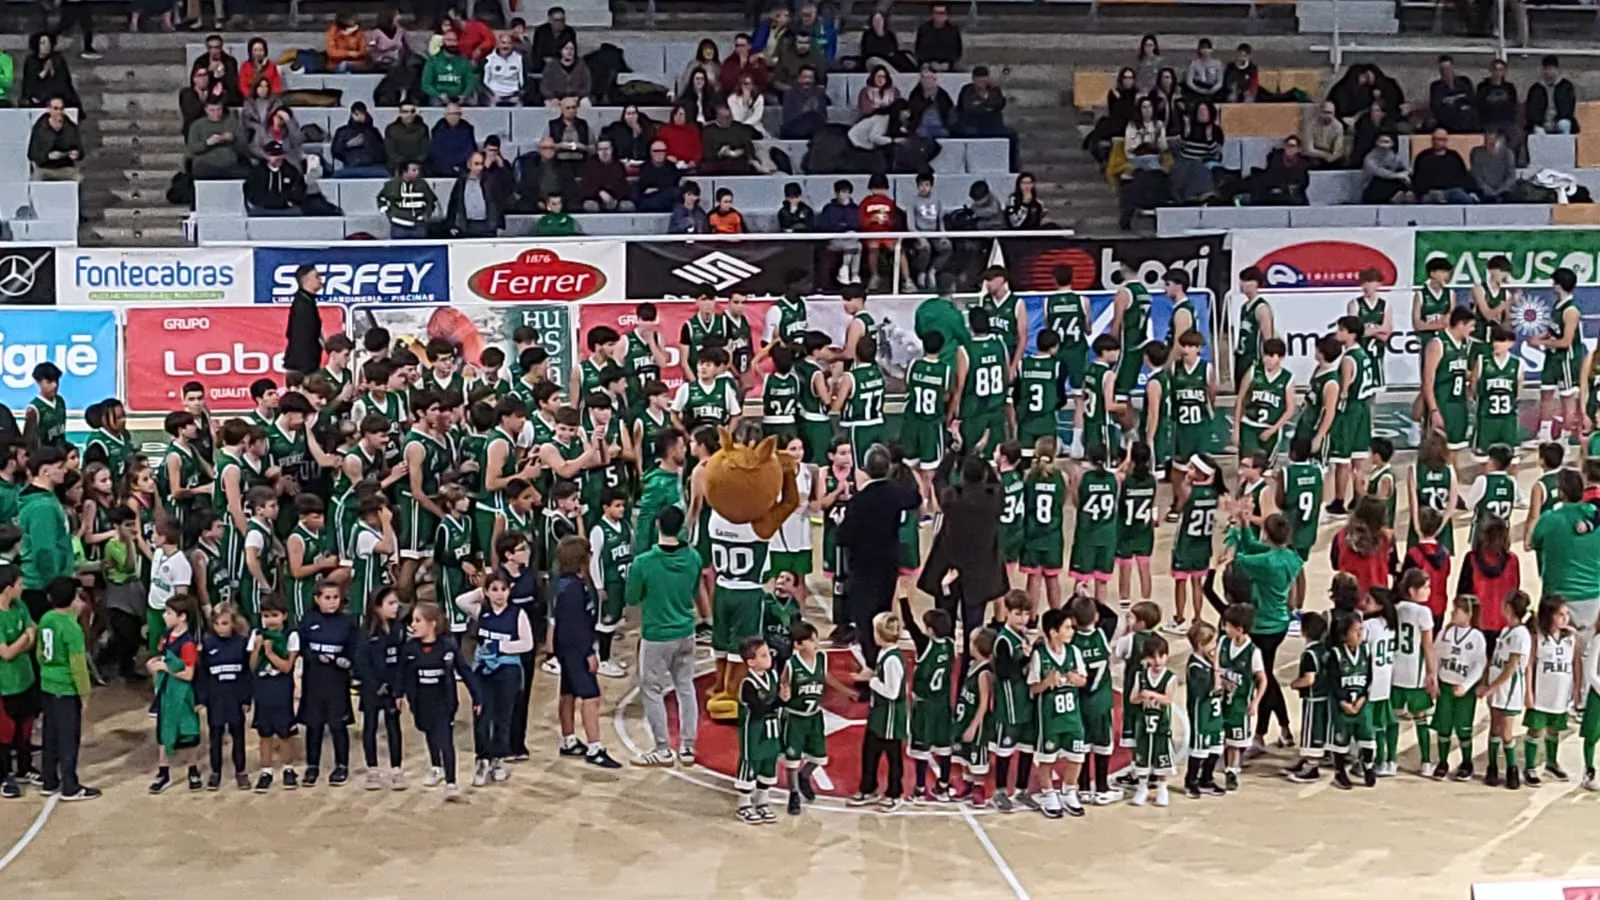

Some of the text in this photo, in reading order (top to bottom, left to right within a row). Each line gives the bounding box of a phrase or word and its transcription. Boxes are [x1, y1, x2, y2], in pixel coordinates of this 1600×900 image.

[525, 254, 551, 263] 1876
[489, 269, 591, 295] Ferrer
[391, 294, 435, 302] PISCINAS
[163, 318, 210, 330] GRUPO
[1052, 317, 1081, 342] 44
[976, 366, 1003, 396] 88
[1453, 376, 1463, 396] 8
[860, 389, 884, 420] 77
[914, 387, 937, 415] 18
[1029, 384, 1044, 411] 3
[1489, 395, 1512, 414] 33
[1179, 406, 1203, 424] 20
[1258, 409, 1269, 423] 2
[605, 466, 619, 488] 5
[1000, 494, 1025, 523] 34
[1037, 494, 1053, 523] 8
[1083, 494, 1114, 521] 49
[1125, 499, 1152, 525] 14
[1300, 492, 1314, 521] 9
[711, 543, 754, 576] 00
[1089, 661, 1108, 691] 7
[804, 700, 816, 713] 7
[955, 703, 965, 722] 9
[1055, 692, 1076, 713] 88
[765, 718, 779, 739] 11
